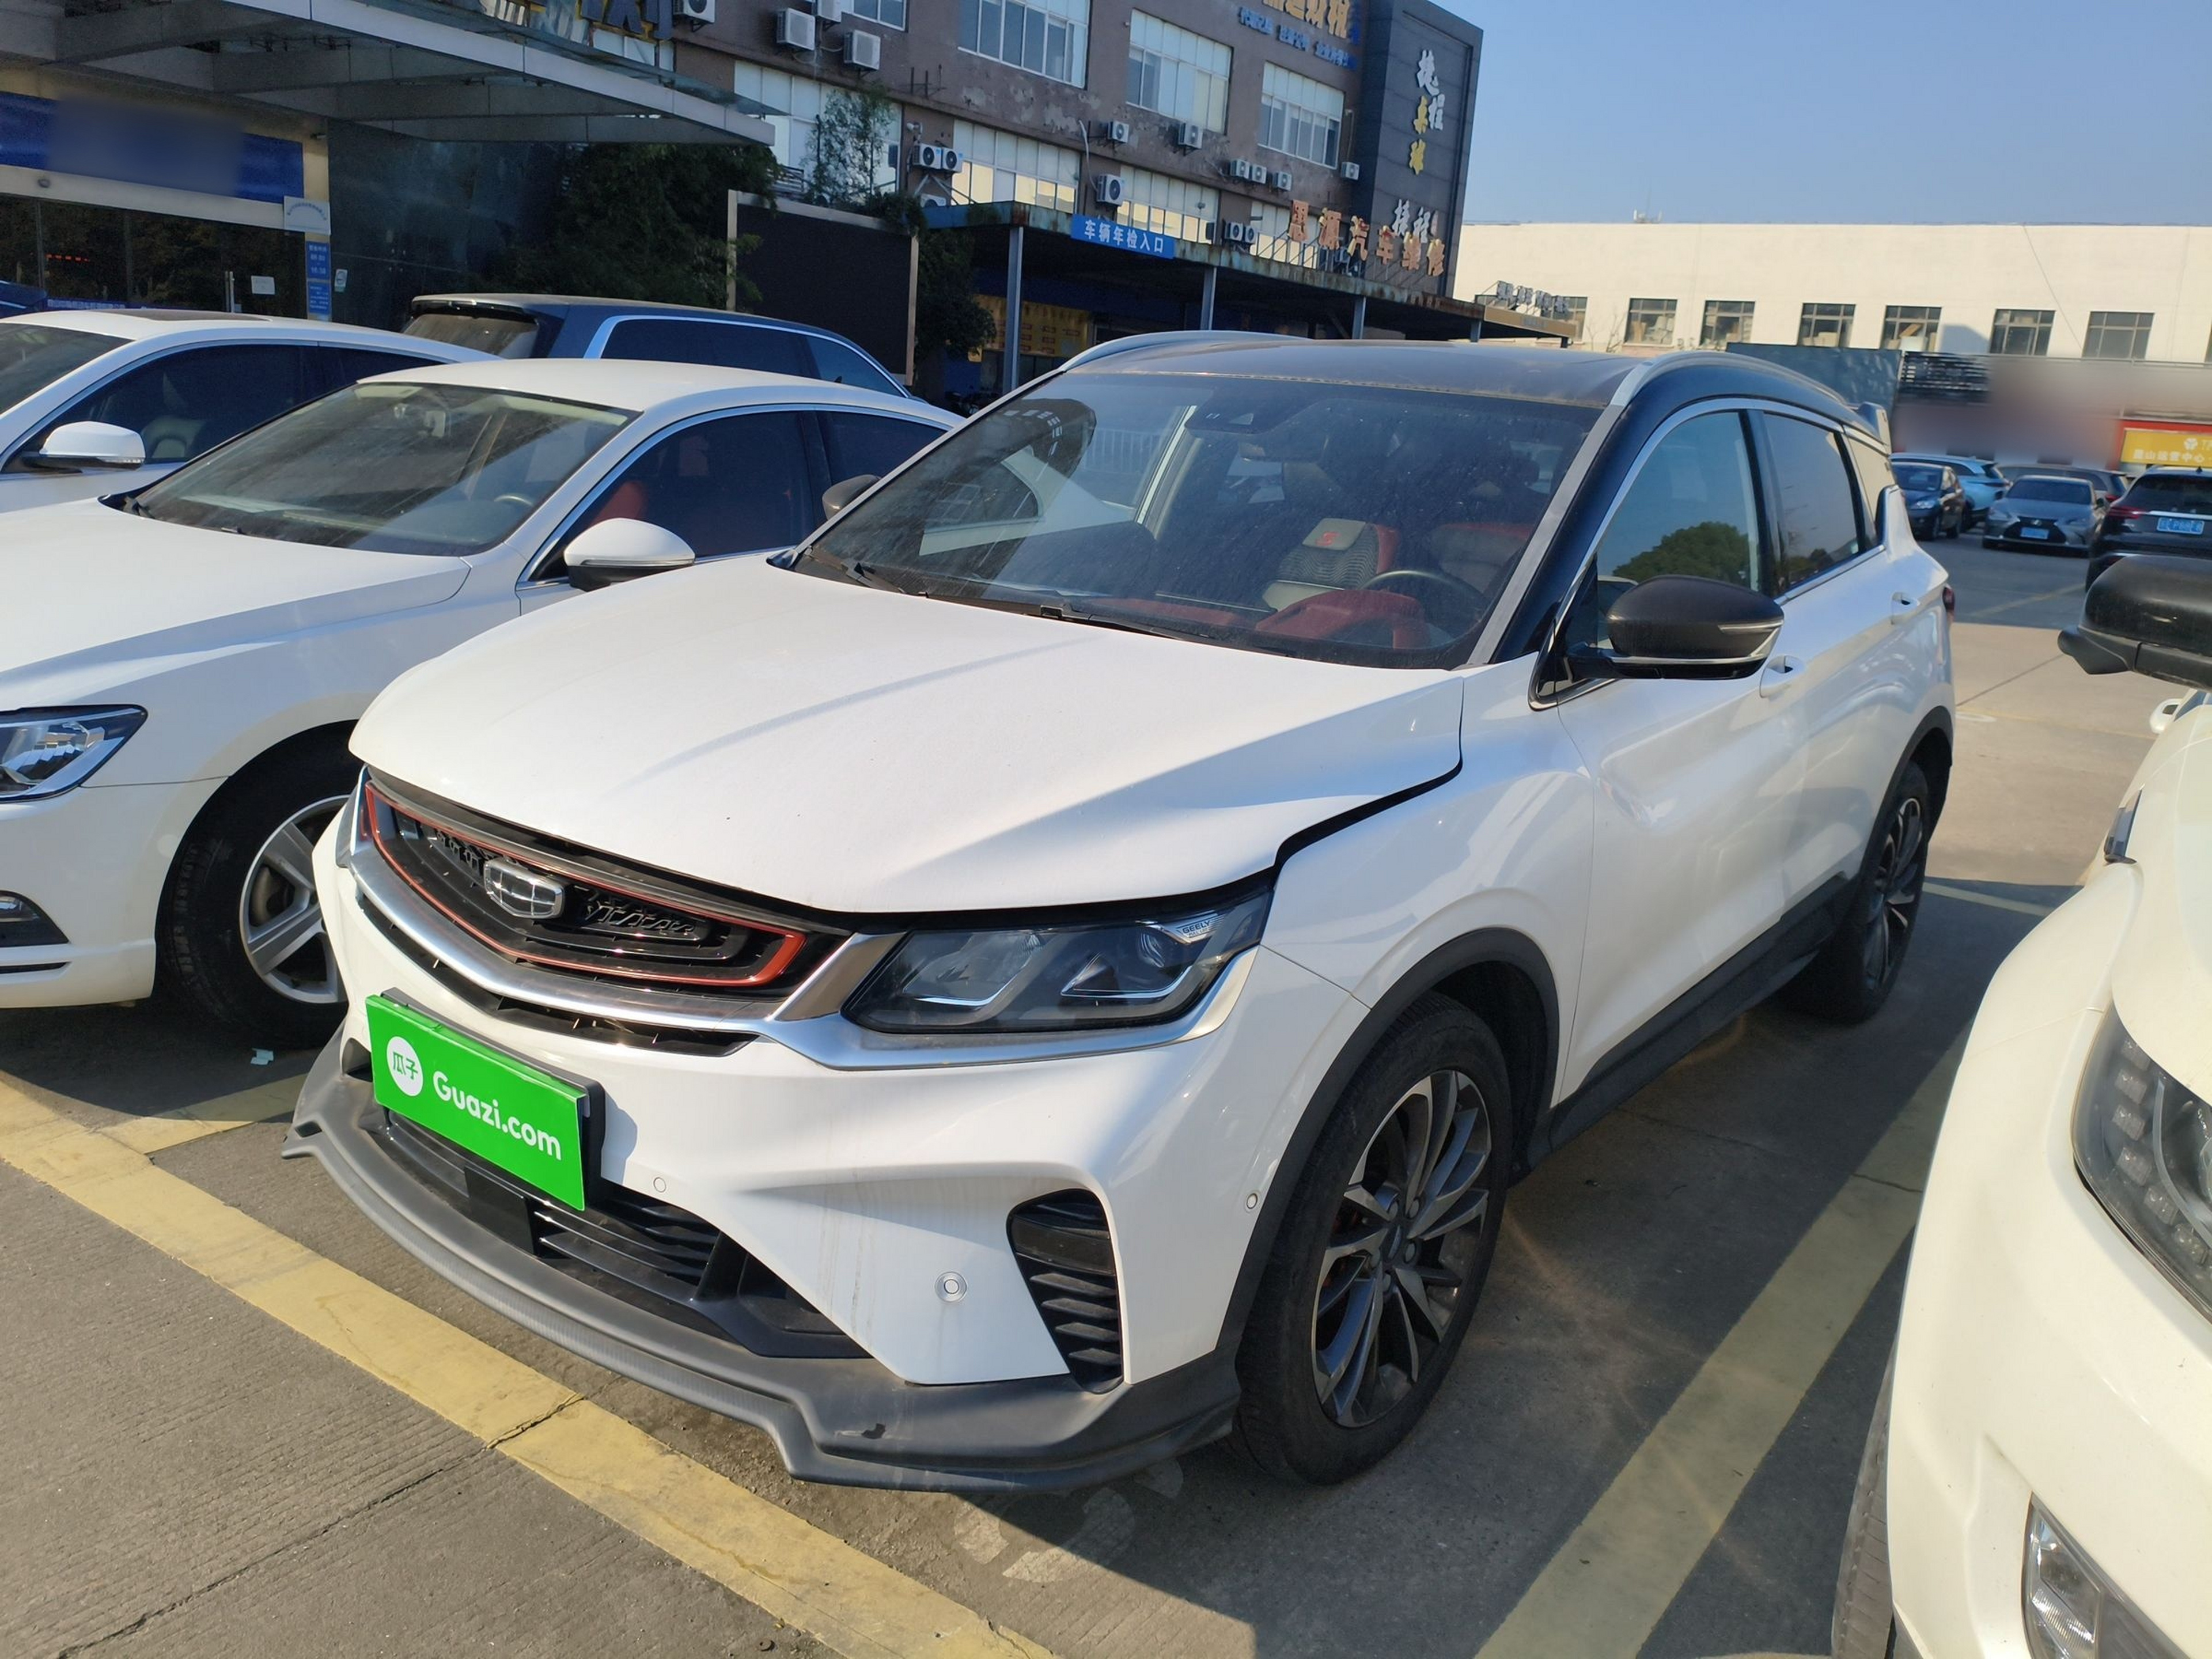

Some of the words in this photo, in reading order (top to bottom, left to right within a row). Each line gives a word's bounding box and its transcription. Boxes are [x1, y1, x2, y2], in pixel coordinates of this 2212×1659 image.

[1084, 219, 1164, 253] 车辆年检入口
[1183, 921, 1210, 933] GEELY
[392, 1052, 418, 1081] 瓜子
[433, 1071, 562, 1161] Guazi.com
